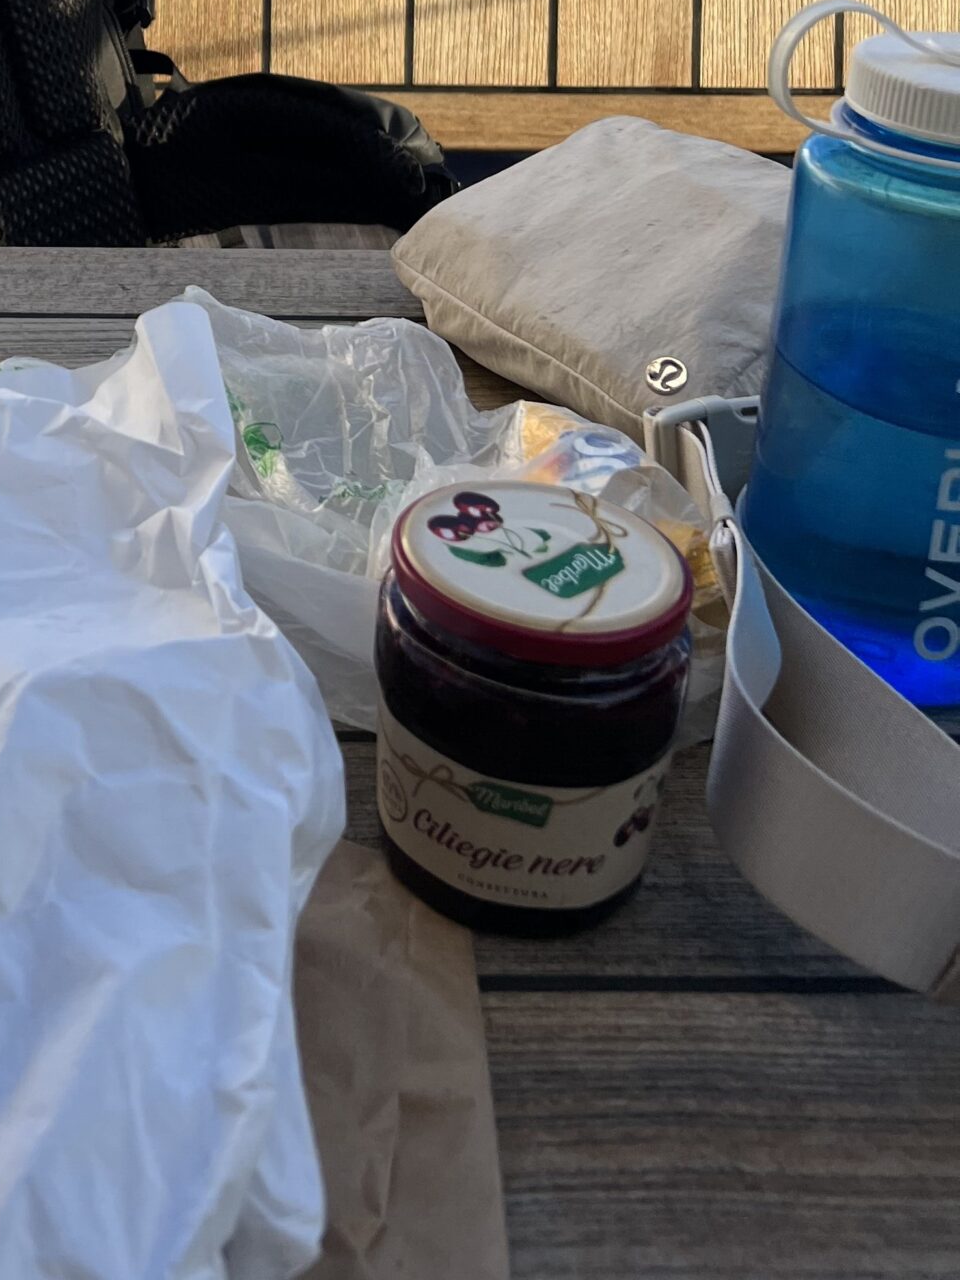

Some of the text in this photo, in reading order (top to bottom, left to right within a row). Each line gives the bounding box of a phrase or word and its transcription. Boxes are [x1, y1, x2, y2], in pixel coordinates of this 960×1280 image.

[913, 376, 960, 662] OVER
[540, 548, 616, 593] Maribel
[413, 809, 605, 876] Ciliegie nere
